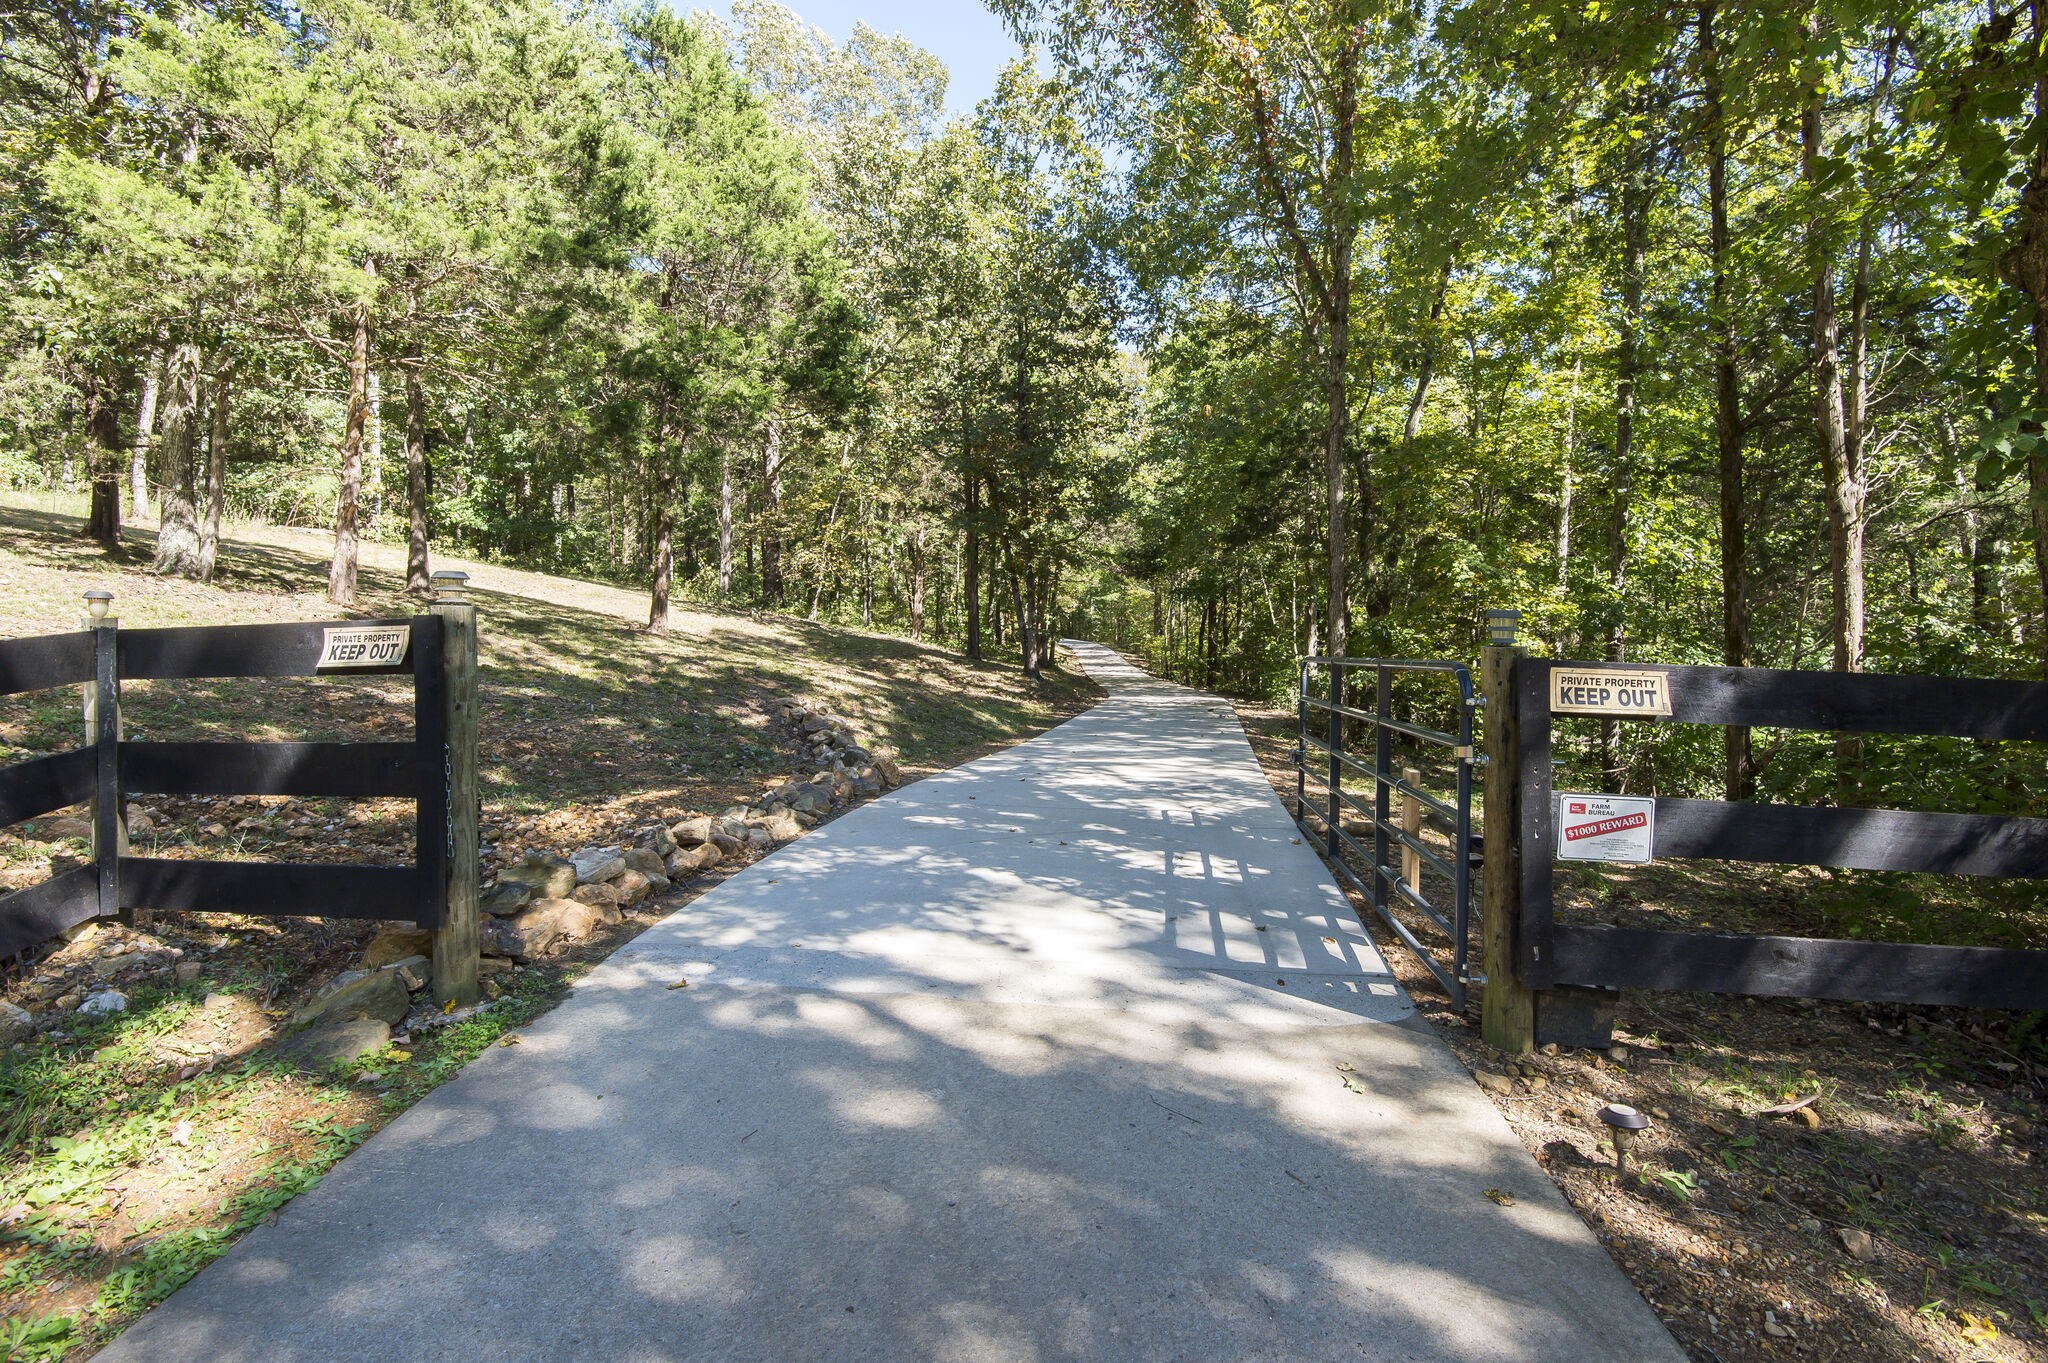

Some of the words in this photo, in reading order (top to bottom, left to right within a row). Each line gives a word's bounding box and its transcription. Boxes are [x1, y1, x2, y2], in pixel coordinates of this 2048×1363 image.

[333, 635, 361, 643] PRIVATE
[364, 633, 400, 642] PROPERTY
[328, 644, 366, 660] KEEP
[369, 643, 399, 659] OUT
[1561, 676, 1601, 686] PRIVATE
[1604, 678, 1655, 688] PROPERTY
[1560, 686, 1610, 705] KEEP
[1618, 688, 1656, 707] OUT
[1567, 825, 1597, 838] $1000
[1599, 815, 1644, 832] REWARD
